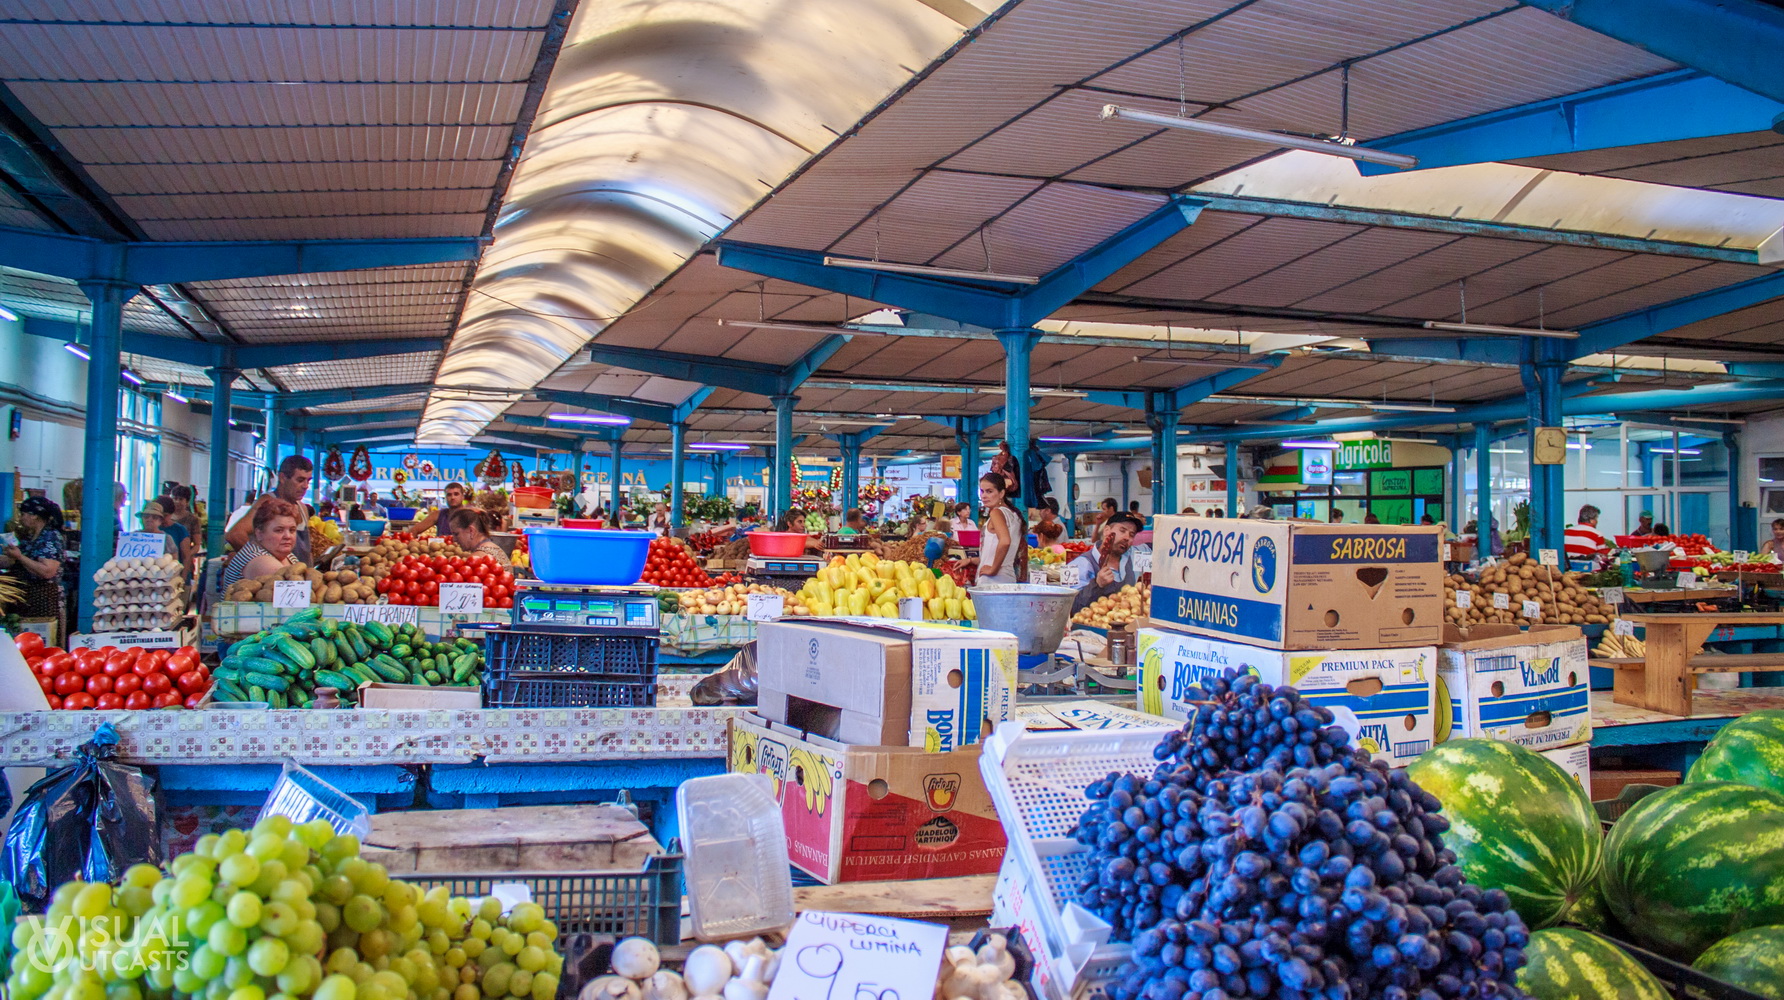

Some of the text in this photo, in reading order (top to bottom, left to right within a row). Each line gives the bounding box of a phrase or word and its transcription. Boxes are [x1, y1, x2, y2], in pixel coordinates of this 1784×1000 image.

[1335, 440, 1391, 468] Agricola
[1169, 527, 1245, 565] SABROSA
[1254, 538, 1277, 554] SABROSA
[1331, 537, 1406, 560] SABROSA
[345, 606, 376, 623] AVEM
[1178, 596, 1239, 627] BANANAS
[1178, 645, 1229, 665] PREMIUM PACK
[1321, 661, 1369, 672] PREMIUM
[1372, 659, 1395, 669] PACK
[1519, 657, 1560, 687] BONITA
[1535, 730, 1571, 745] PREMIUM
[927, 777, 957, 795] Tropy
[794, 839, 828, 868] BANANAS
[845, 853, 901, 867] PREMIUM
[904, 851, 967, 865] CAVENDISH
